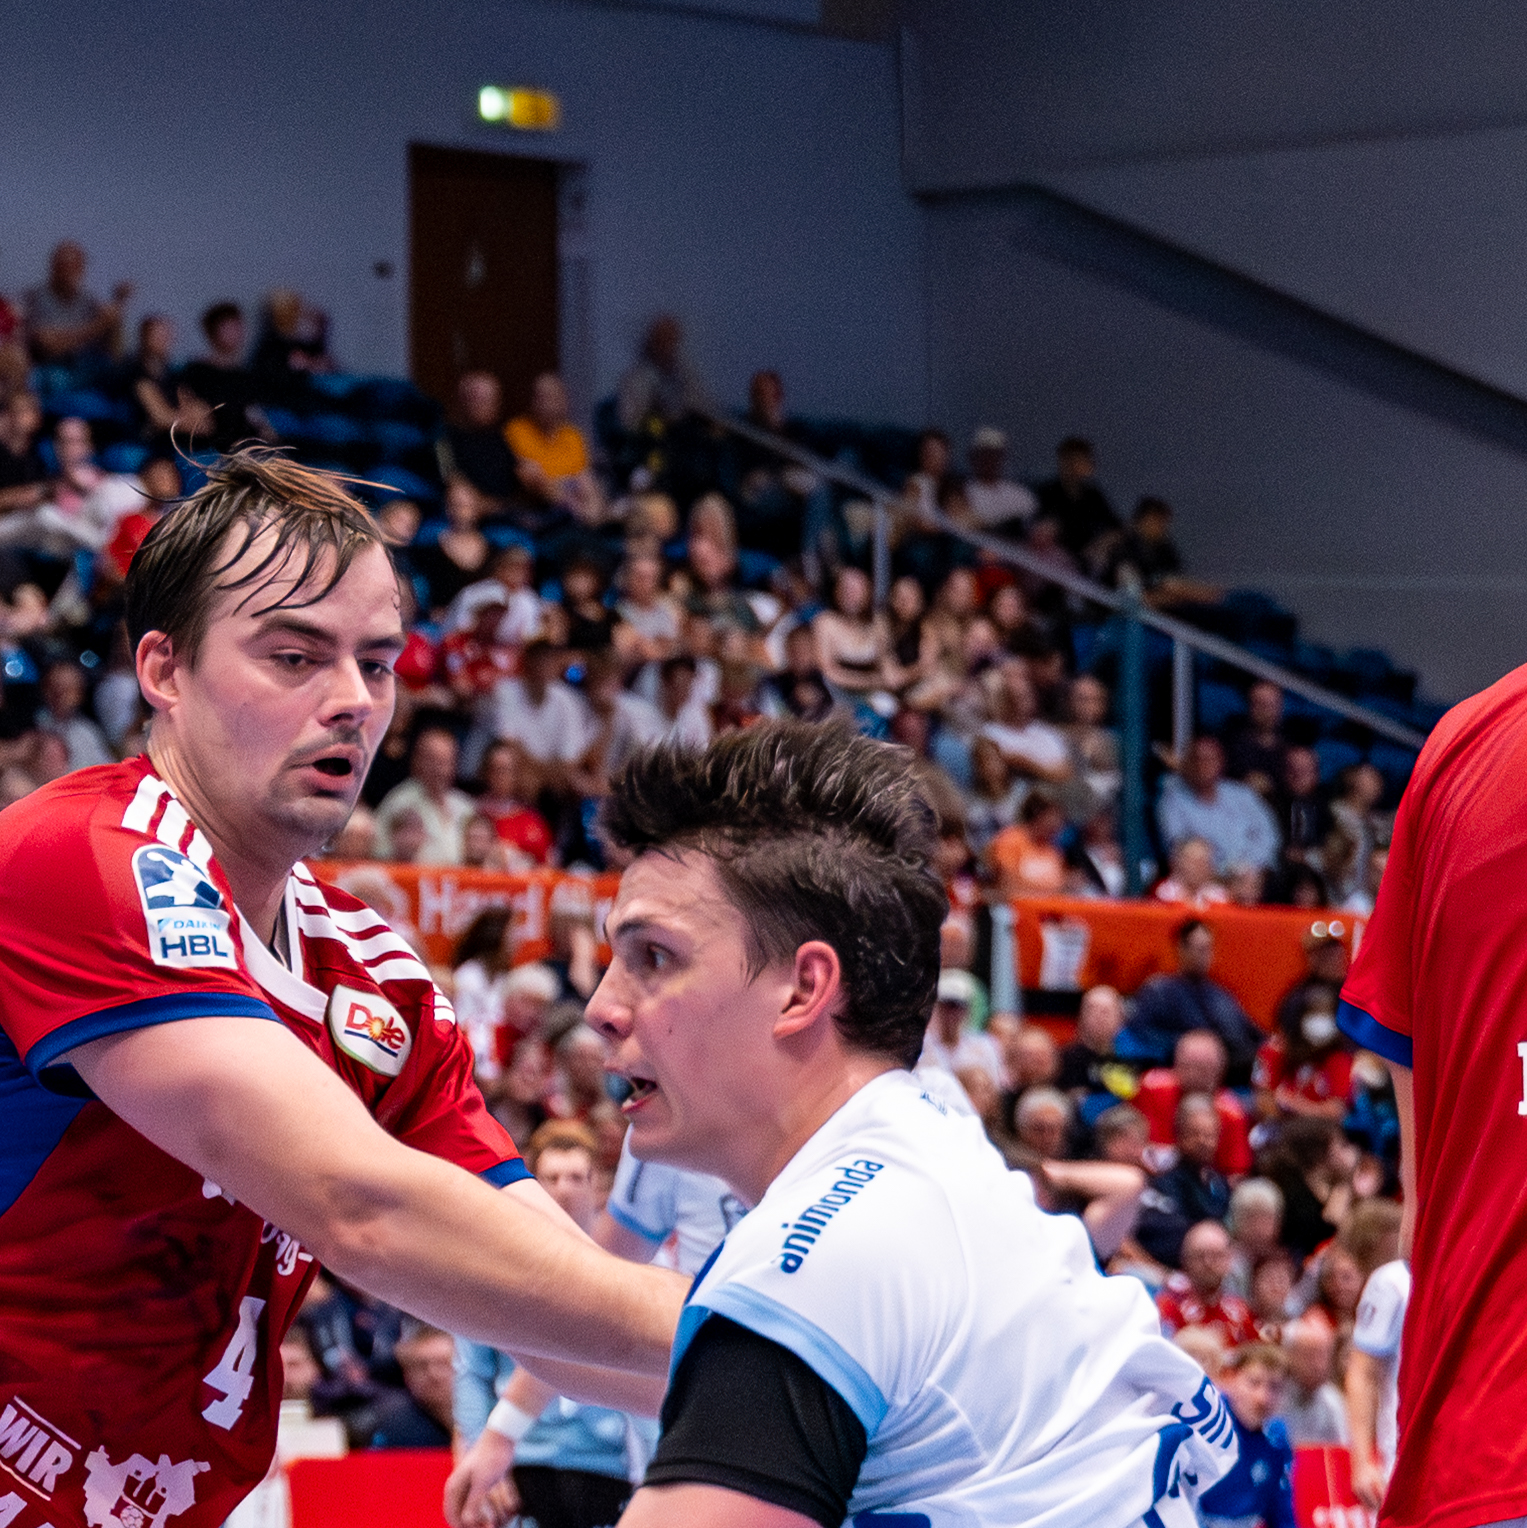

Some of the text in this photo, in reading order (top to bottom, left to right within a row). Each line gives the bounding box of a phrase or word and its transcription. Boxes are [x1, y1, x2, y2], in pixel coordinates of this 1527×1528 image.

[159, 934, 229, 960] HBL
[344, 1001, 406, 1050] Dole
[770, 1158, 885, 1274] animonda
[201, 1295, 267, 1432] 4
